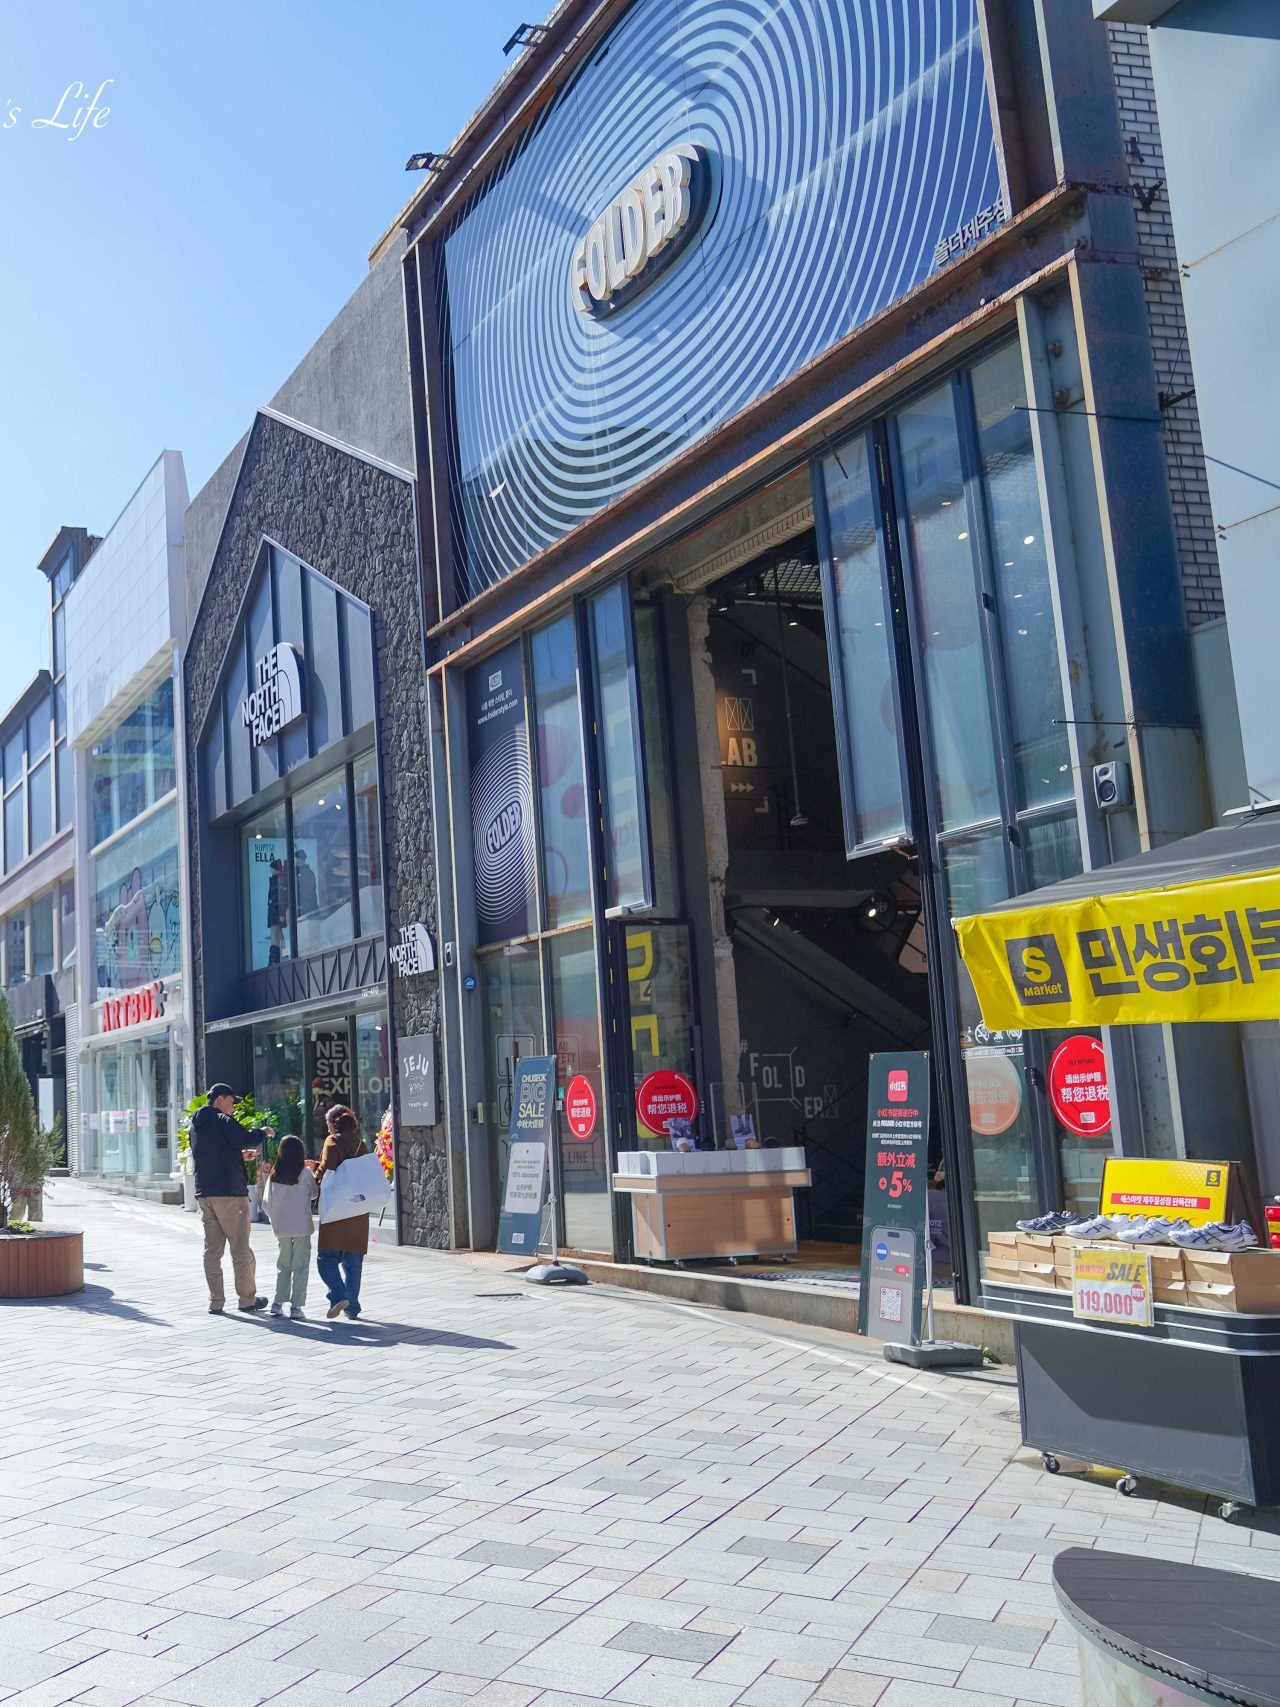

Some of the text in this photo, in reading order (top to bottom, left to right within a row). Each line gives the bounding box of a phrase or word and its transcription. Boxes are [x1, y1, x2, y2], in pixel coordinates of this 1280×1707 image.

[572, 152, 690, 312] FOLDER
[255, 646, 278, 687] THE
[241, 676, 279, 727] NORTH
[252, 703, 280, 748] FACE
[487, 802, 521, 853] FOLDER
[255, 852, 275, 862] ELLA
[399, 924, 417, 944] THE
[389, 940, 418, 964] NORTH
[399, 956, 419, 978] FACE
[1019, 947, 1052, 983] S
[102, 982, 163, 1033] ARTBOX
[1065, 1072, 1102, 1084] 请出示护照
[520, 1083, 546, 1103] BIG
[1061, 1085, 1109, 1103] 帮您退税
[519, 1102, 544, 1118] SALE
[647, 1102, 687, 1115] 帮您退税
[876, 1151, 915, 1168] 额外立减
[1106, 1262, 1145, 1282] SALE
[1078, 1289, 1133, 1316] 119,000
